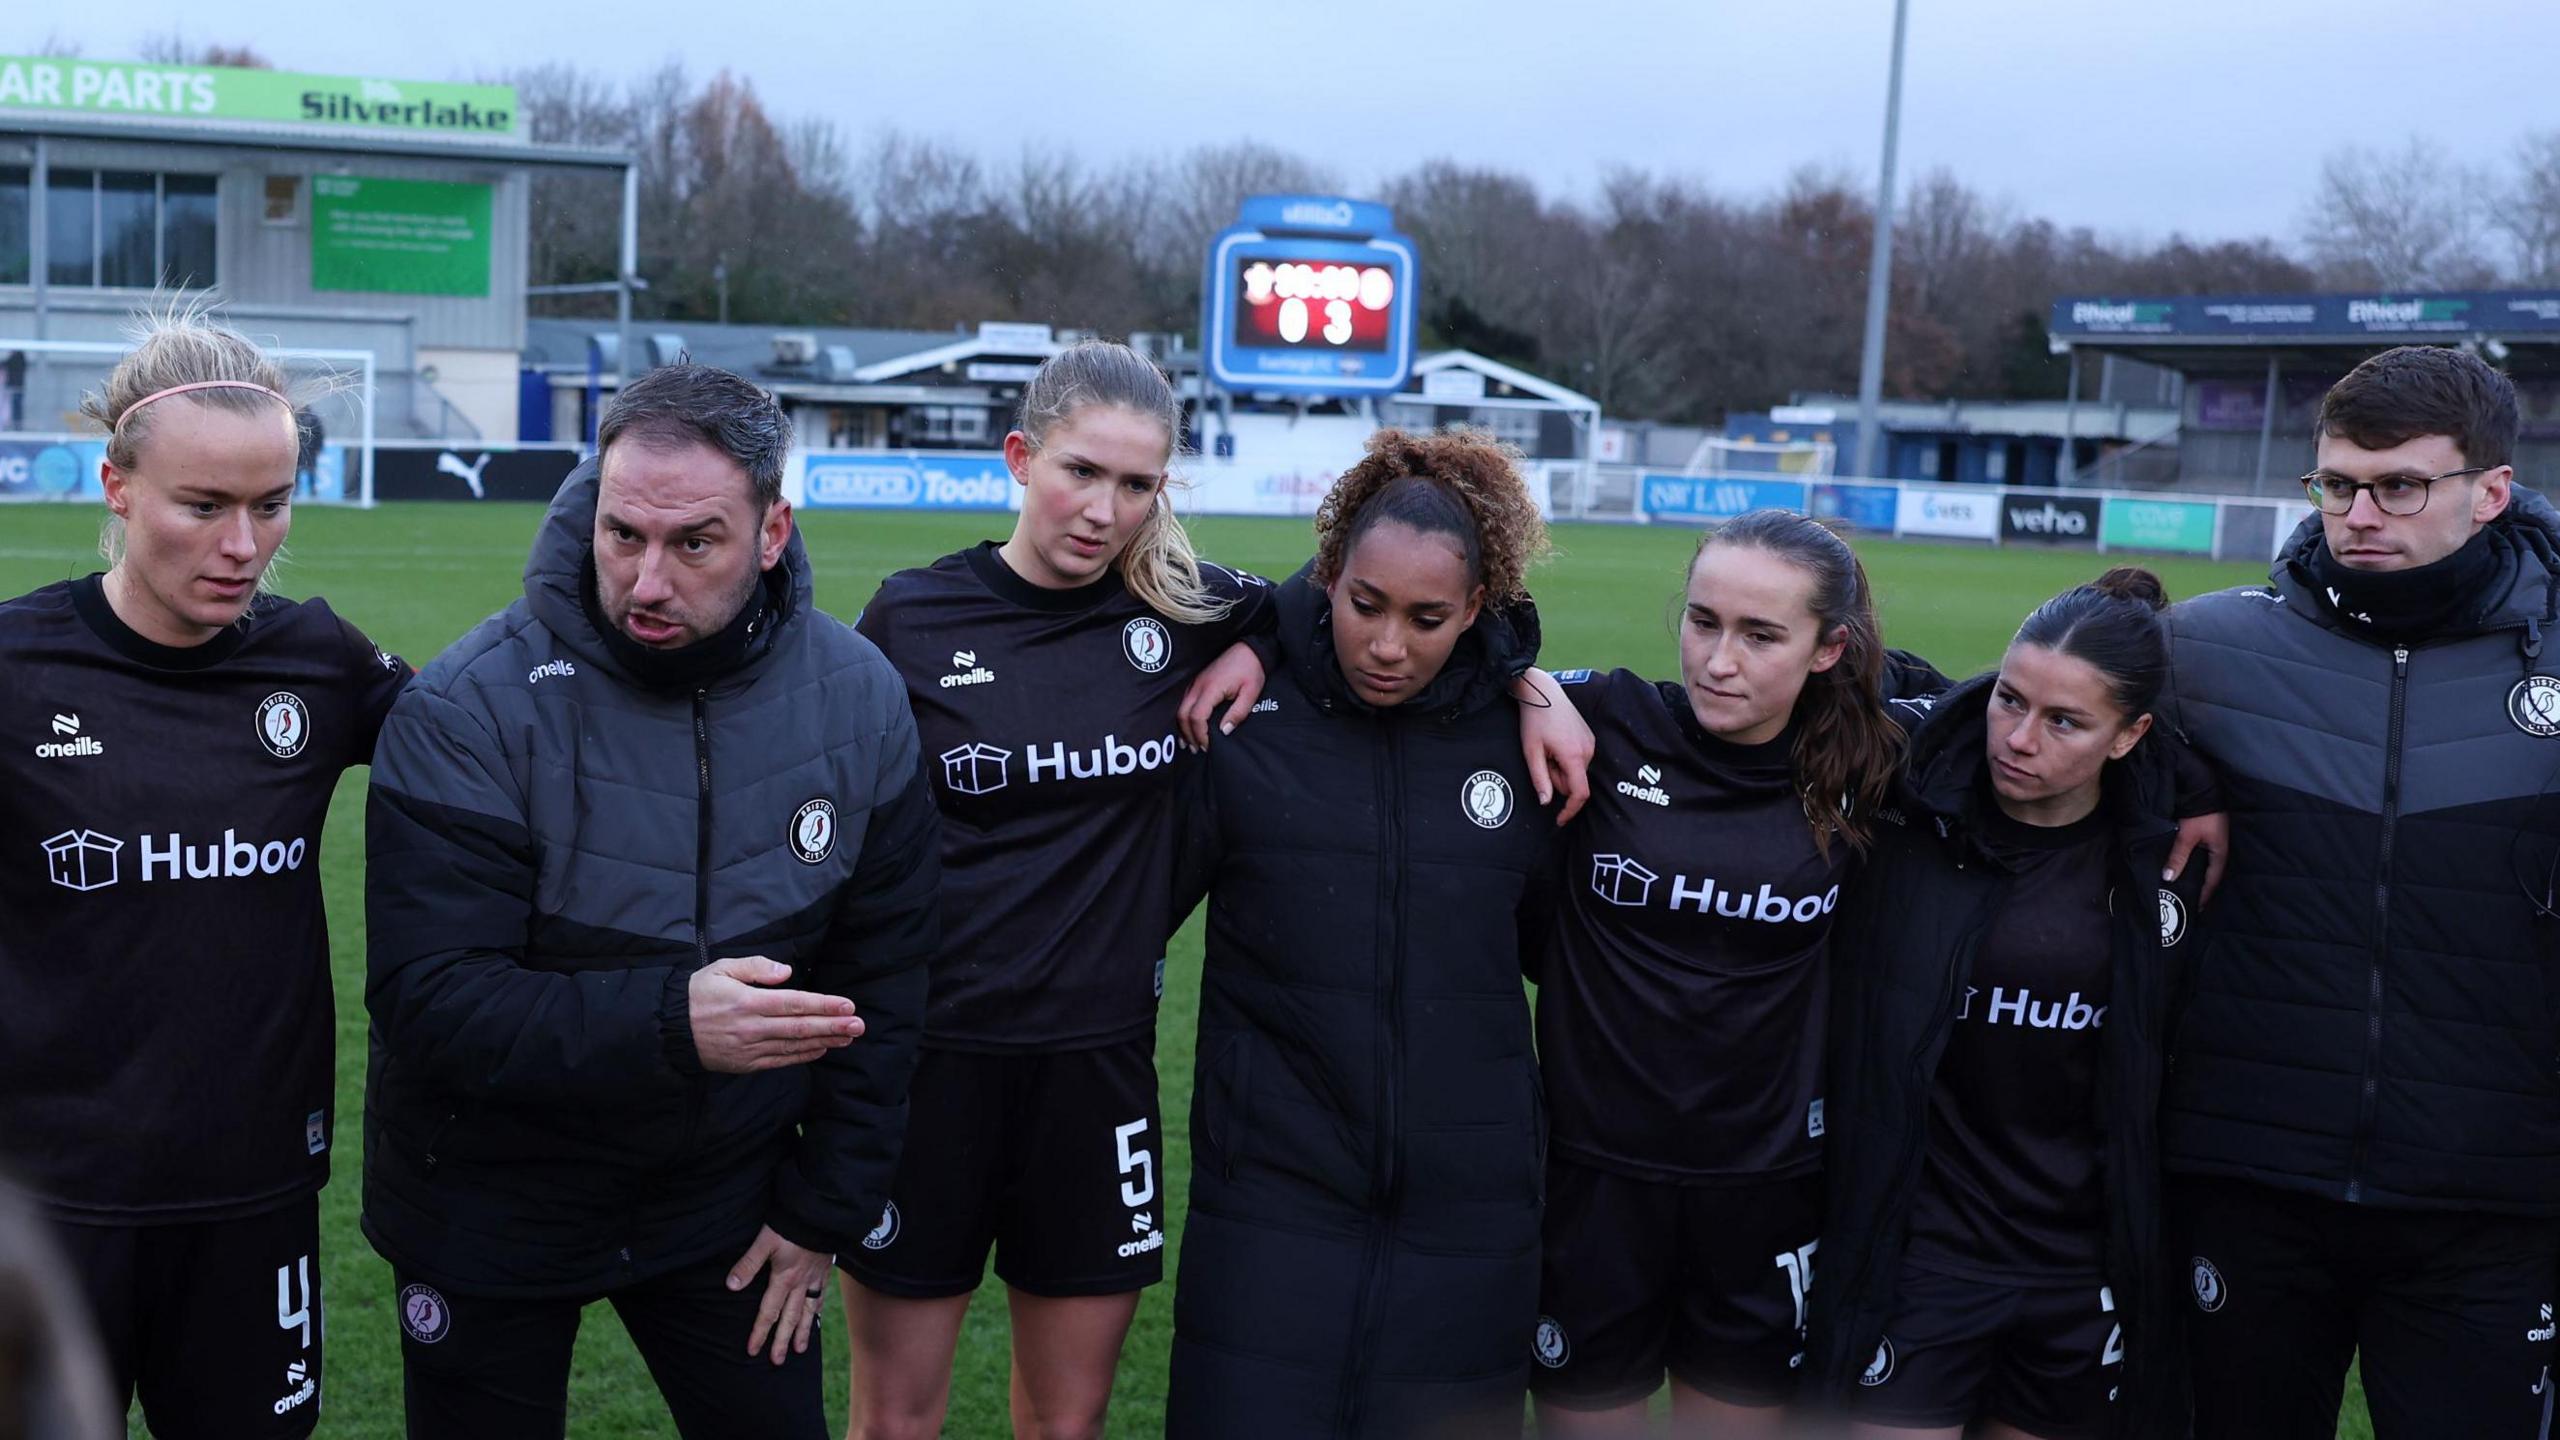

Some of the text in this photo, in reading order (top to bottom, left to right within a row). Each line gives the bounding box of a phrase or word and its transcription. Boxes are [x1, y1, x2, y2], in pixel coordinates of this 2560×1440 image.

[73, 66, 217, 113] PARTS
[300, 90, 510, 131] Silverlake
[1323, 299, 1352, 344] 3
[923, 470, 1008, 503] Tools
[2009, 501, 2087, 535] veho
[1127, 620, 1161, 634] BRISTOL
[1141, 660, 1161, 671] CITY
[263, 694, 300, 711] BRISTOL
[1252, 698, 1280, 713] eills
[276, 744, 298, 755] CITY
[1026, 734, 1176, 784] Huboo
[1471, 773, 1506, 789] BRISTOL
[800, 802, 833, 818] BRISTOL
[1477, 816, 1499, 826] CITY
[140, 828, 306, 882] Huboo
[804, 849, 825, 860] CITY
[1669, 874, 1840, 924] Huboo
[1115, 1117, 1155, 1208] 5
[278, 1255, 311, 1349] 4
